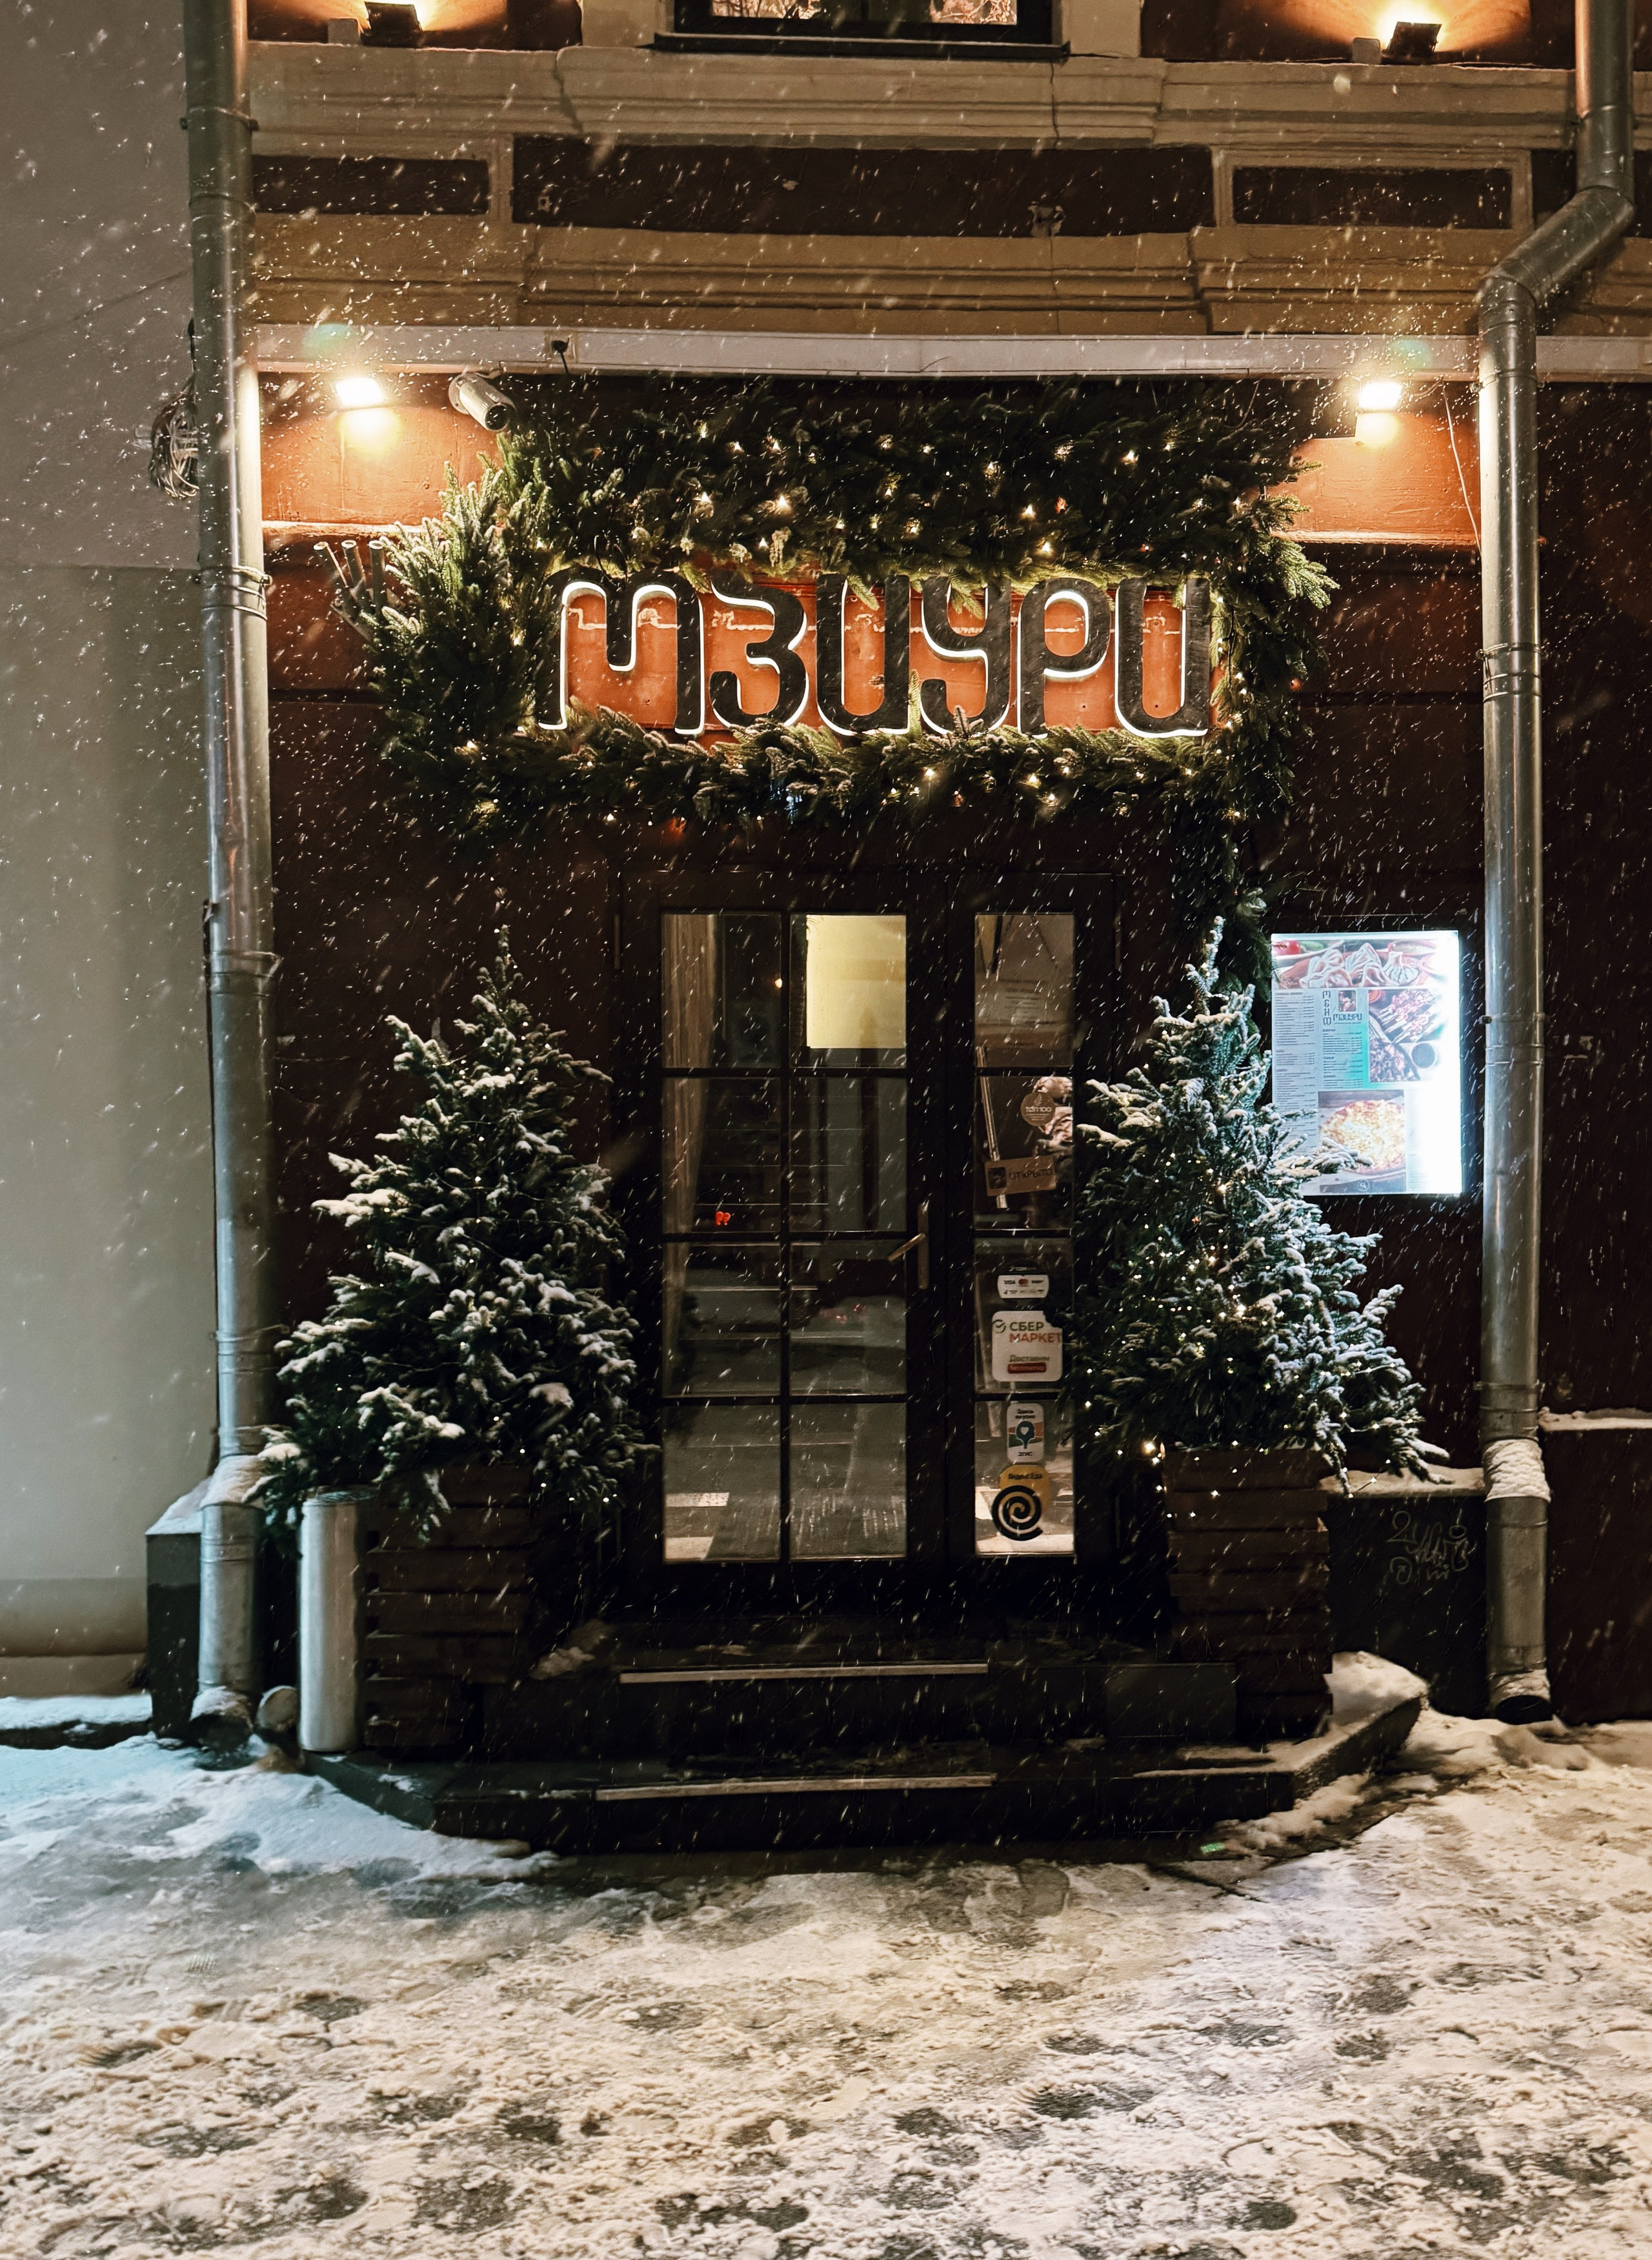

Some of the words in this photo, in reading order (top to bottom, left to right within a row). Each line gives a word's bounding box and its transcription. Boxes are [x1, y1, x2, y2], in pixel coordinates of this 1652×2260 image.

[538, 567, 1211, 740] МЗИУРИ
[1009, 1322, 1044, 1331] СБЕР
[1009, 1333, 1062, 1343] МАРКЕТ
